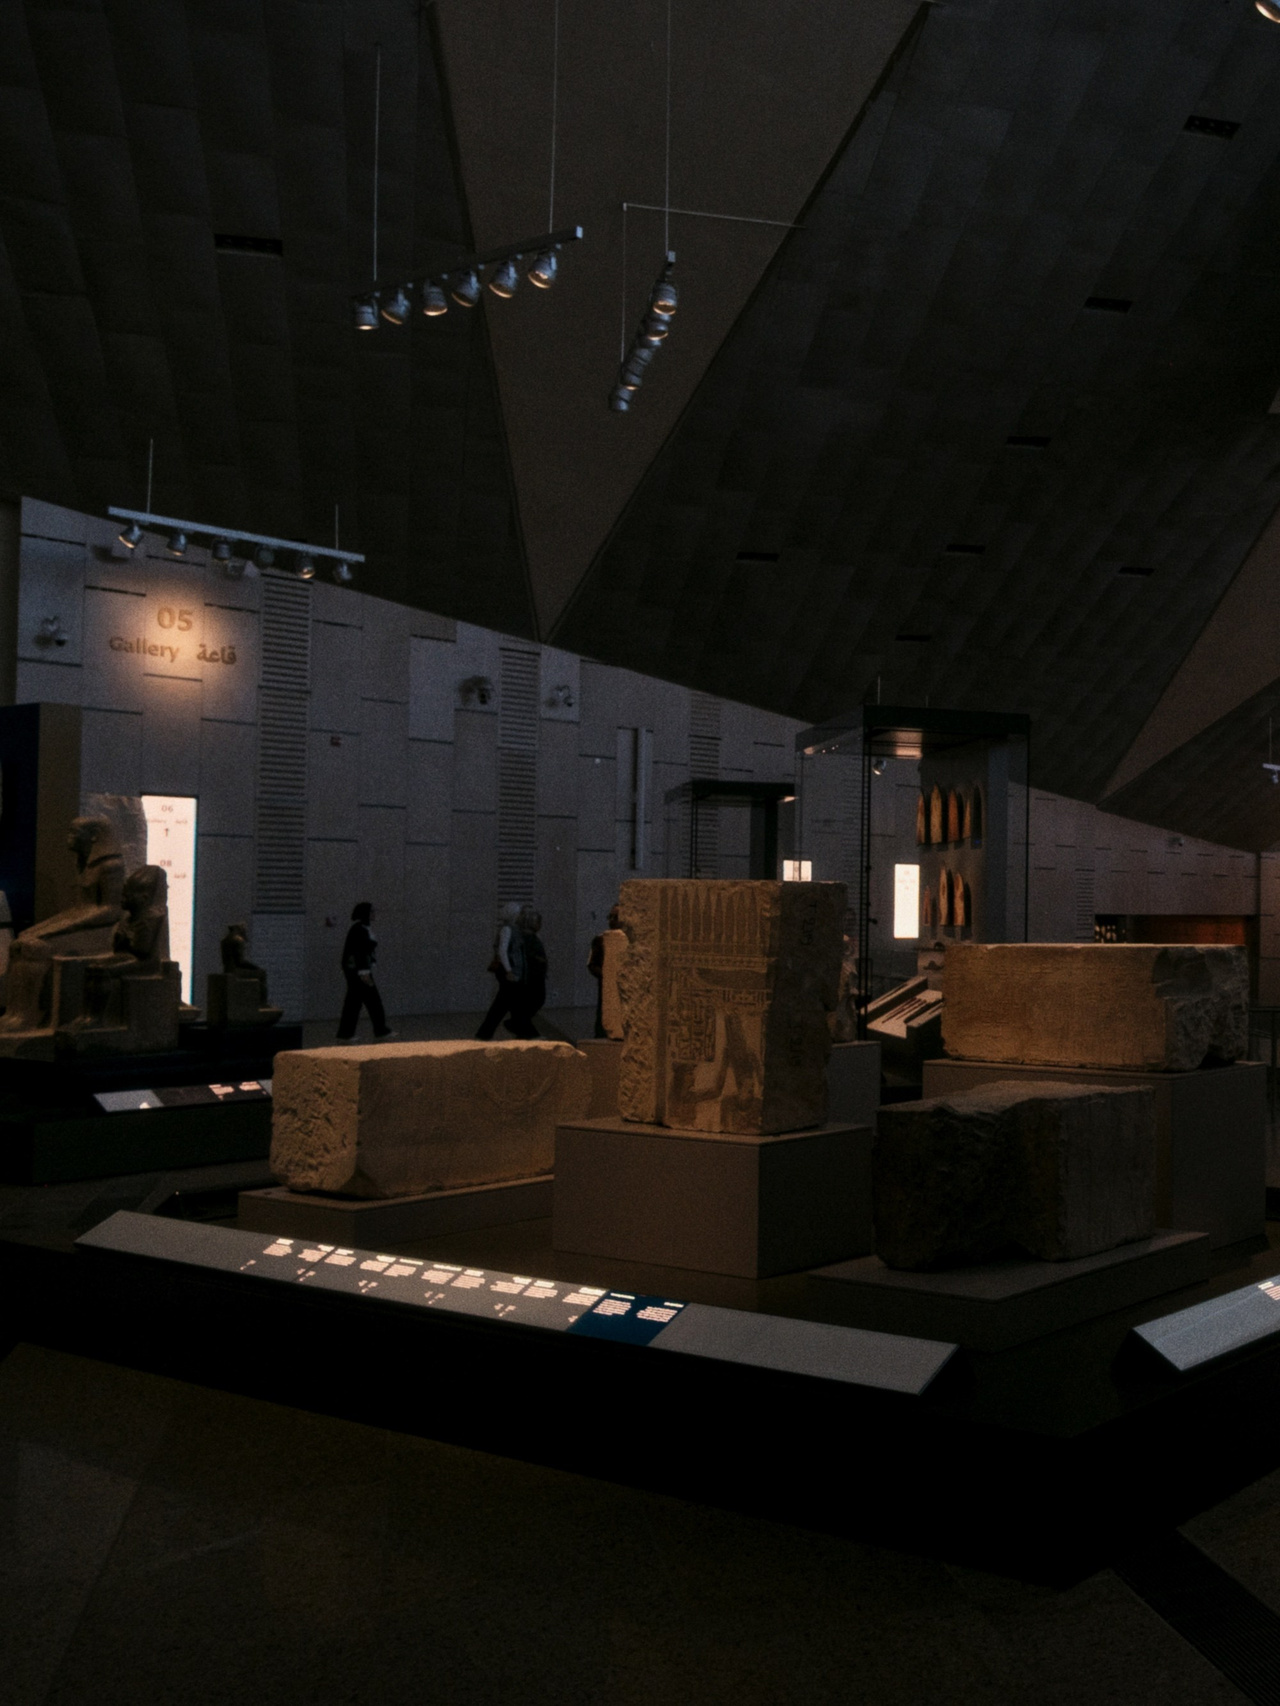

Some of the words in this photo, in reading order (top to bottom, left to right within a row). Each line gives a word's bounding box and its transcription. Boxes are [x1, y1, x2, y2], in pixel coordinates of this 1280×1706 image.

[157, 606, 194, 631] 05
[109, 636, 179, 663] Gallery
[196, 643, 237, 665] قاعة
